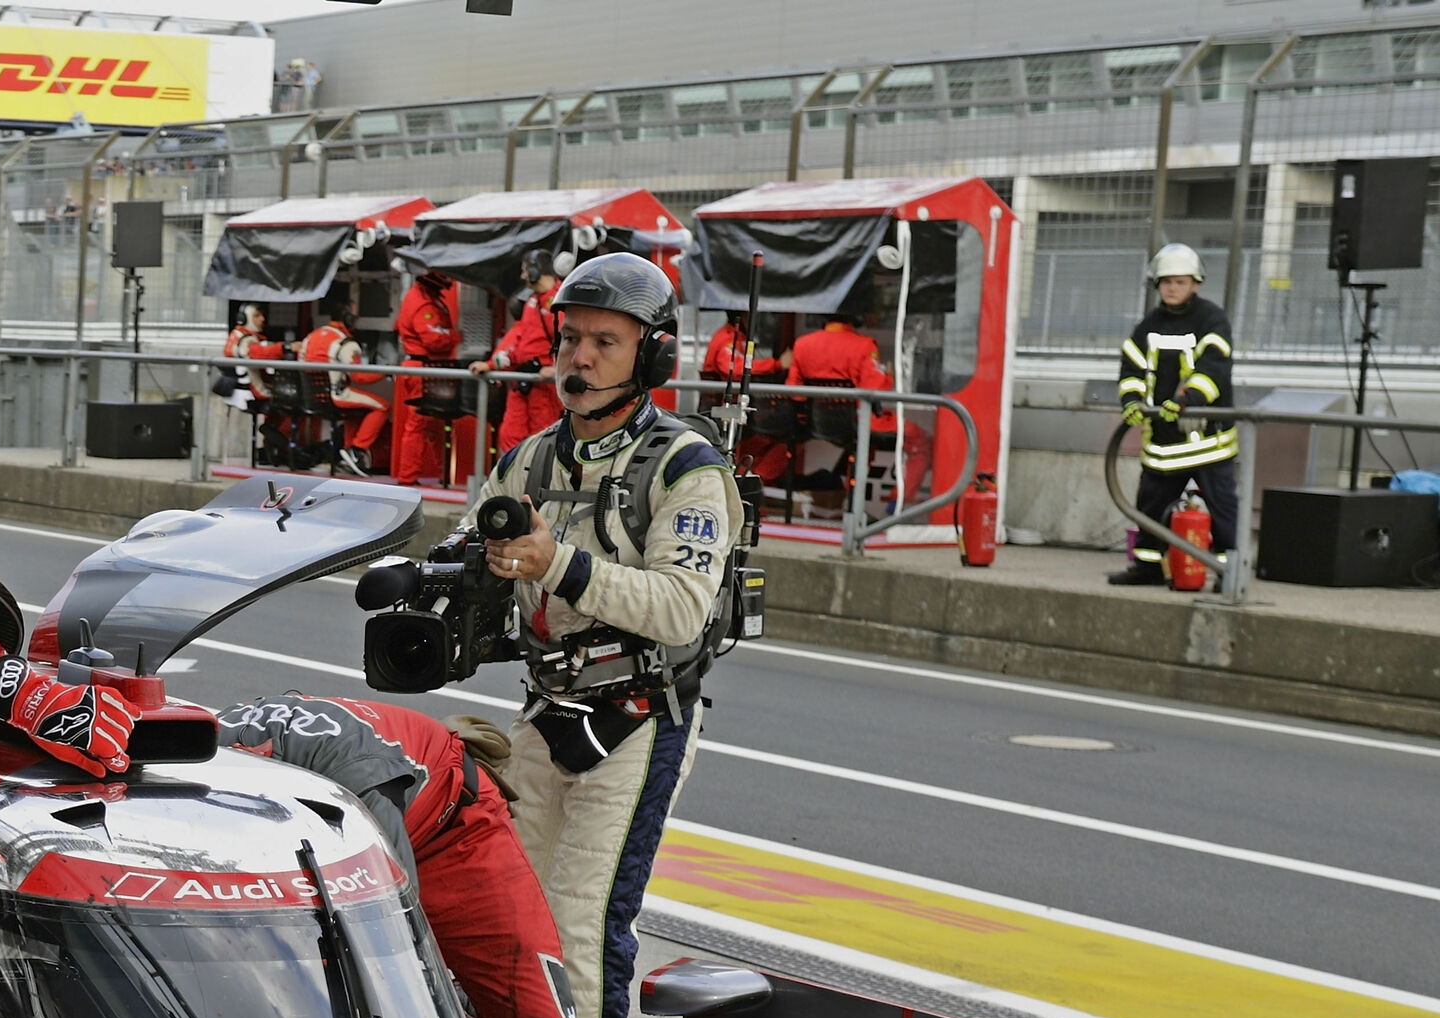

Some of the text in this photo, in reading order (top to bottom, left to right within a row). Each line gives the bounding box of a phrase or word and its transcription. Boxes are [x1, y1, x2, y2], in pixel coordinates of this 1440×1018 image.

[671, 545, 713, 576] 28
[173, 866, 379, 902] Audi Sport
